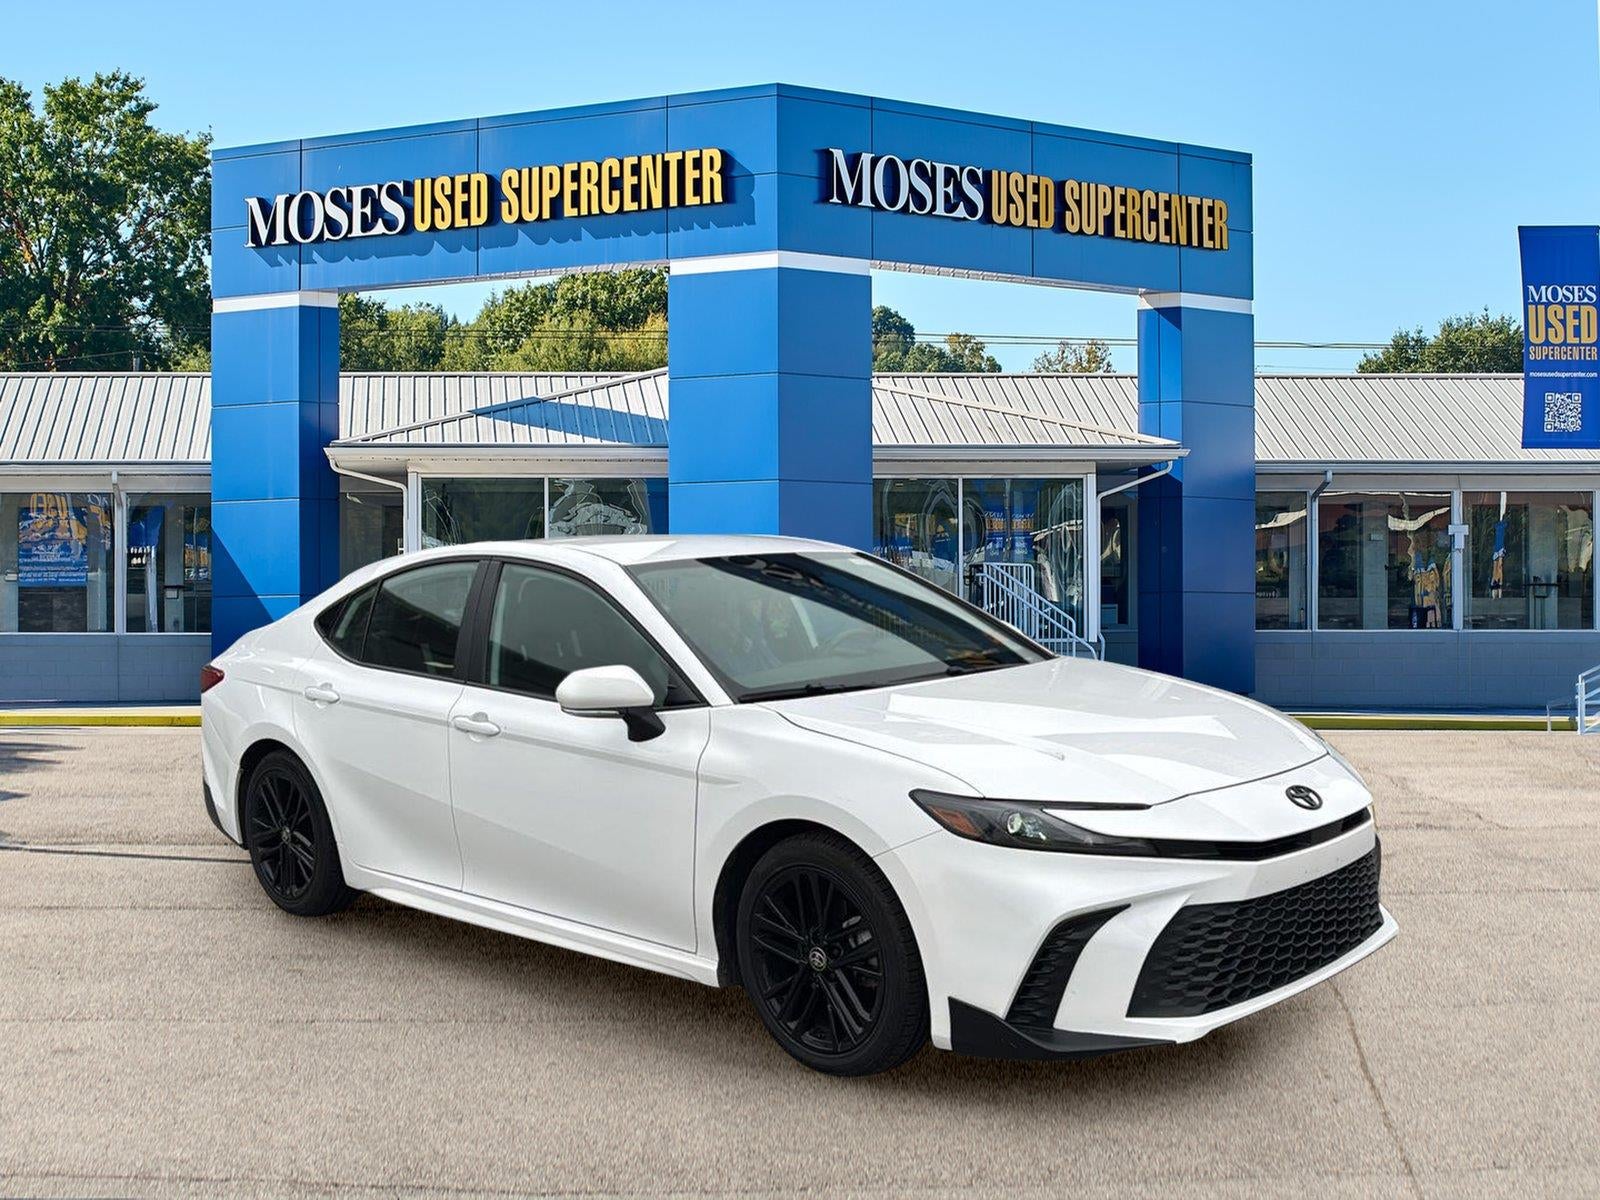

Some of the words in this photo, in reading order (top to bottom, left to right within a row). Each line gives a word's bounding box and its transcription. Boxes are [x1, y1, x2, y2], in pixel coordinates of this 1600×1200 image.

[245, 181, 406, 248] MOSES
[412, 172, 490, 232] USED
[500, 148, 723, 225] SUPERCENTER
[829, 149, 984, 221] MOSES
[991, 169, 1055, 229] USED
[1065, 179, 1229, 250] SUPERCENTER
[1527, 285, 1597, 303] MOSES
[1528, 304, 1598, 344] USED
[1529, 346, 1598, 361] SUPERCENTER
